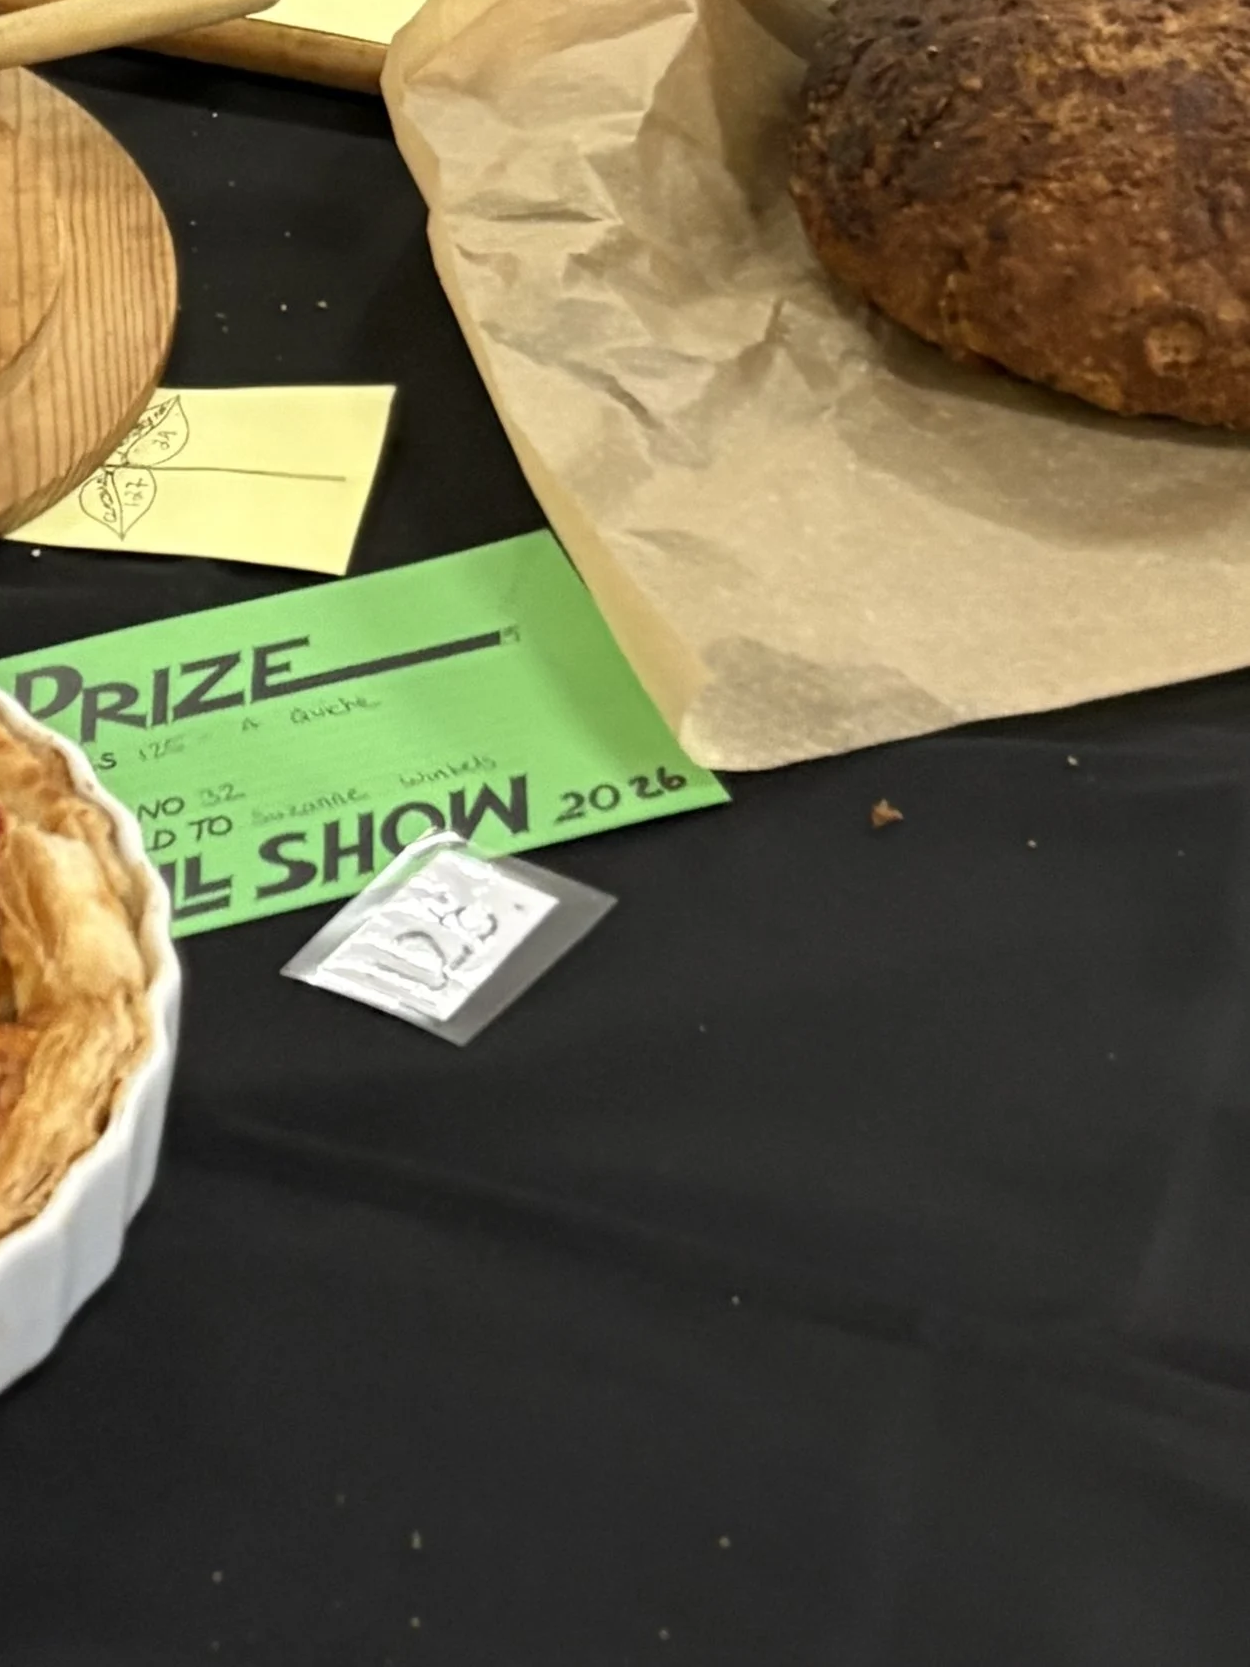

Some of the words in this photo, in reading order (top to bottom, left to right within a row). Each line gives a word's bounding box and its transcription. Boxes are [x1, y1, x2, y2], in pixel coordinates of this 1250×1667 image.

[14, 635, 311, 744] PRIZE
[137, 797, 185, 820] NO
[189, 815, 234, 841] TO
[256, 773, 531, 901] SHOW
[554, 765, 688, 824] 2026
